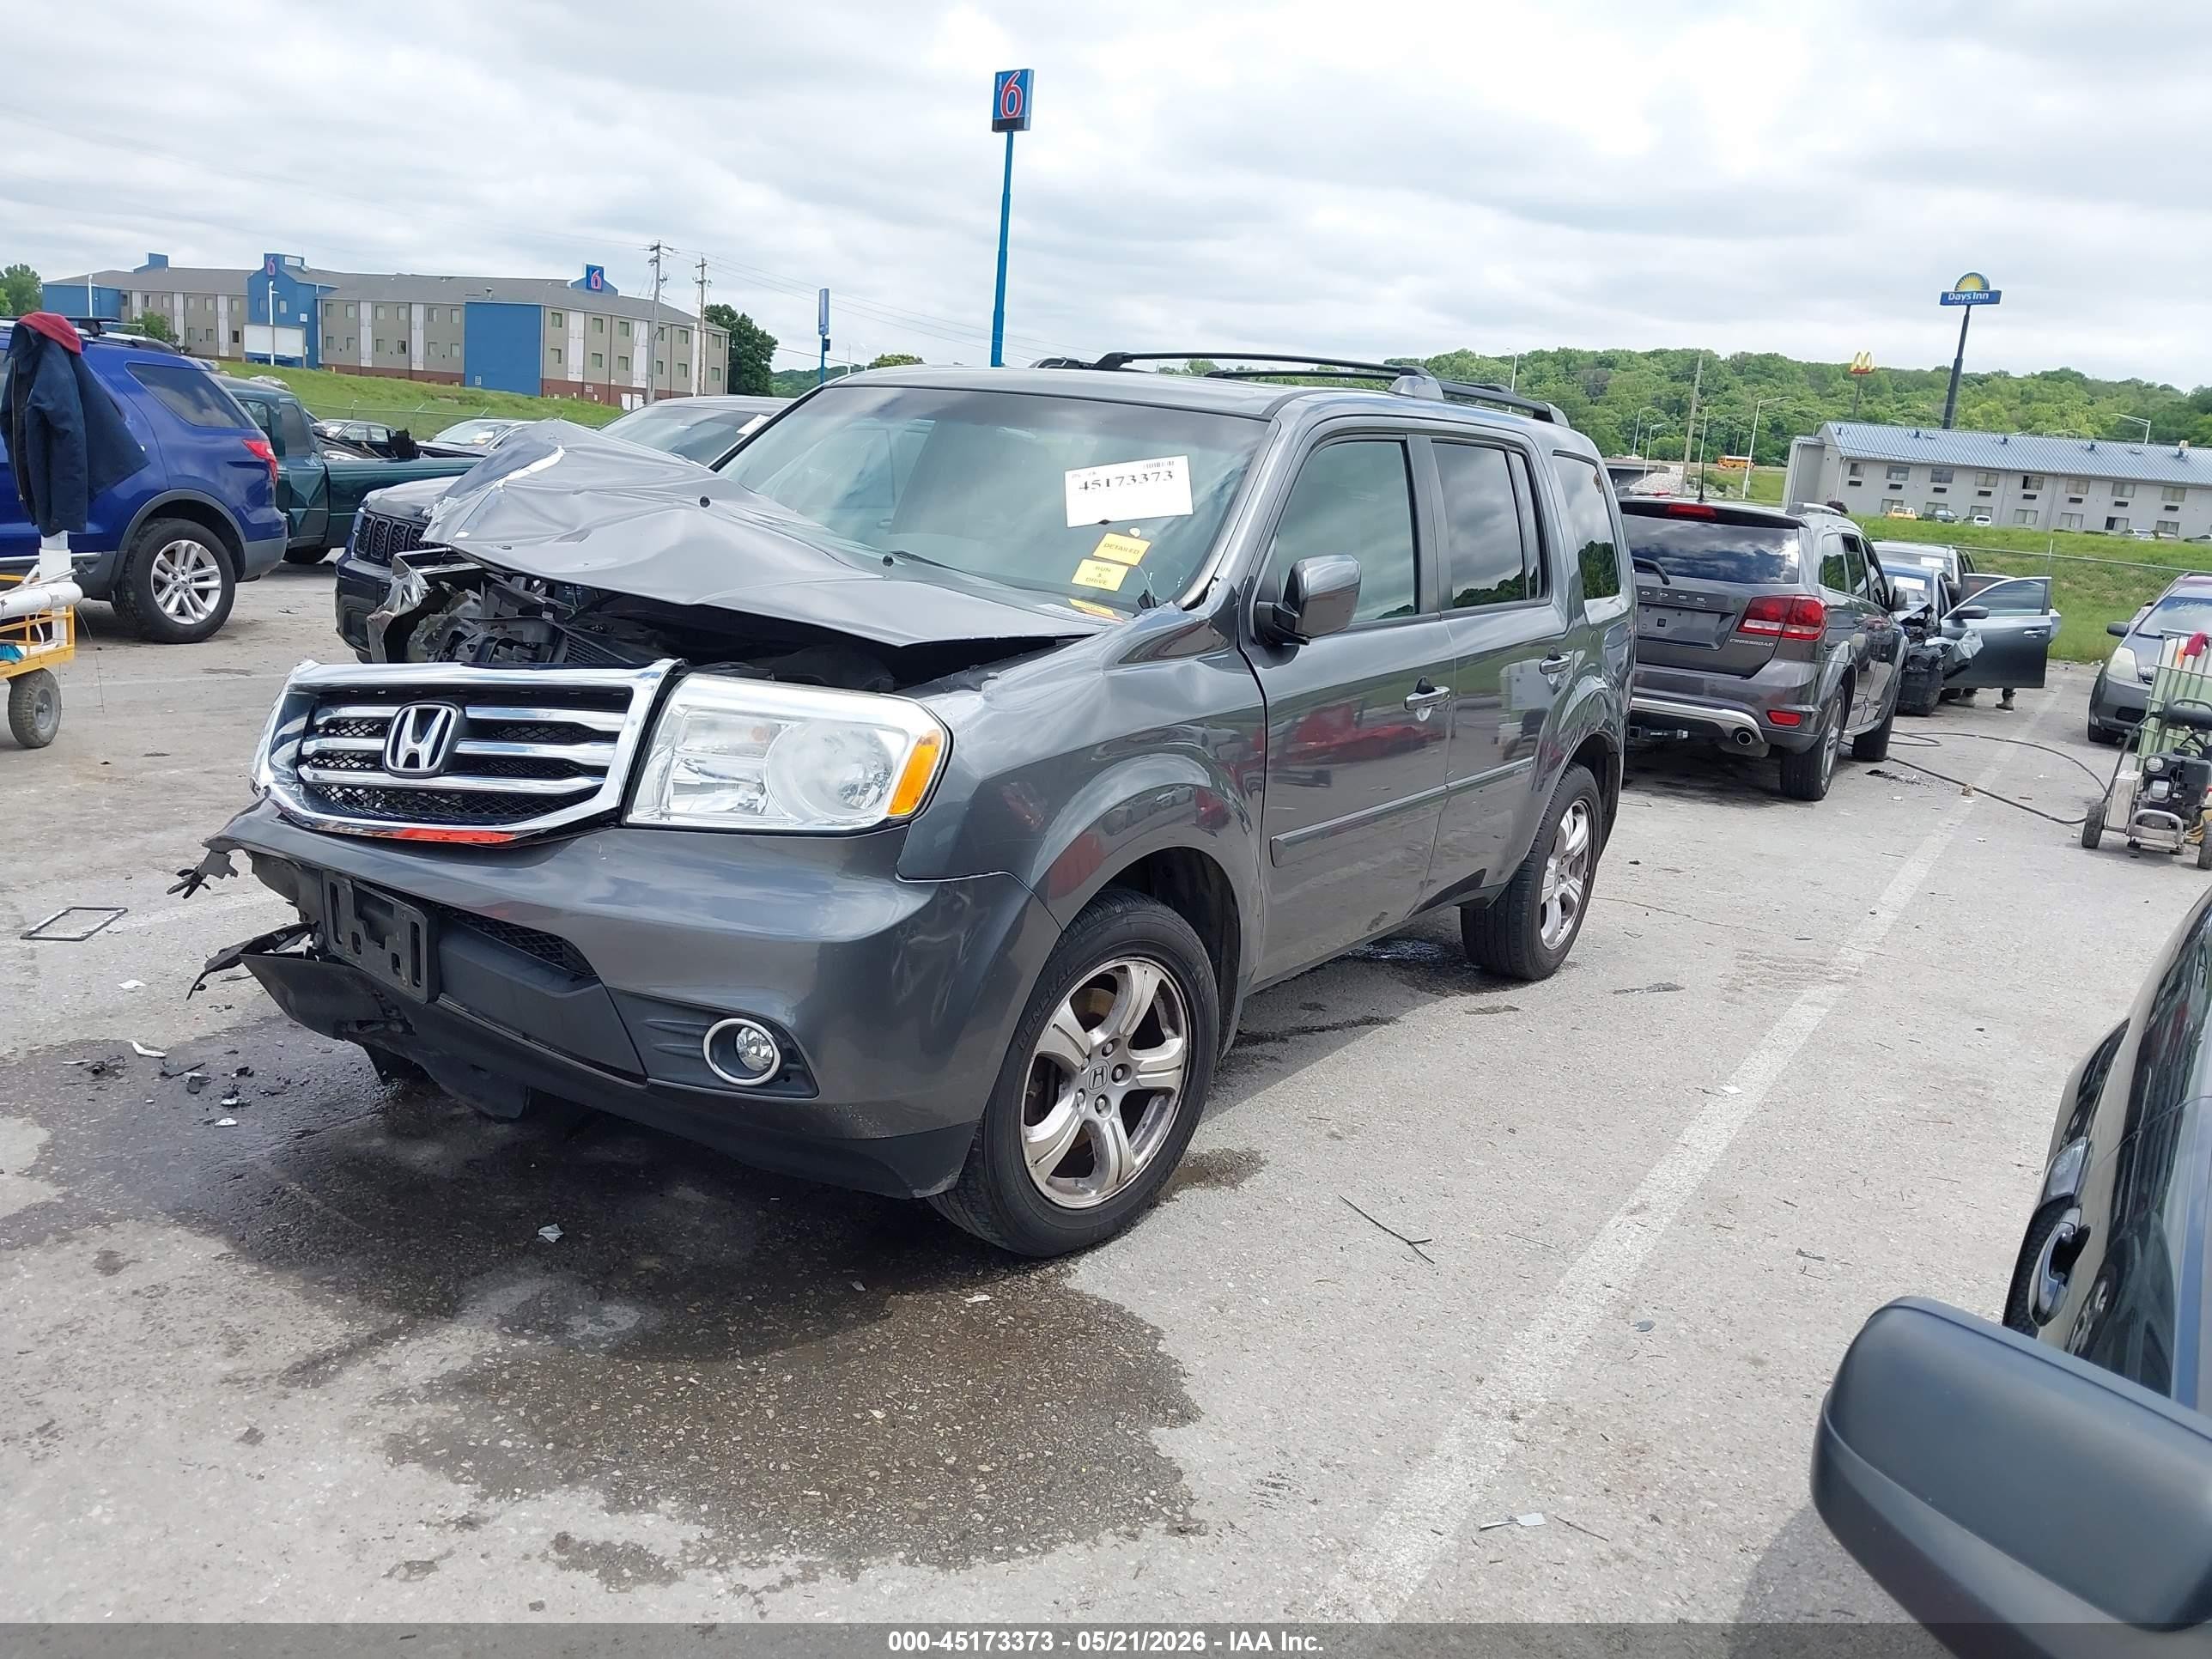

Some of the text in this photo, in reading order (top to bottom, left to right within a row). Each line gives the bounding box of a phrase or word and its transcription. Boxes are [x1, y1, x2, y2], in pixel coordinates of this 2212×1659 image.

[1000, 70, 1023, 118] 6
[591, 269, 602, 289] 6
[1948, 292, 1989, 301] Days Inn
[1079, 470, 1174, 491] 45173373
[1103, 542, 1140, 555] DETAILED
[1729, 638, 1774, 647] CROSSROAD
